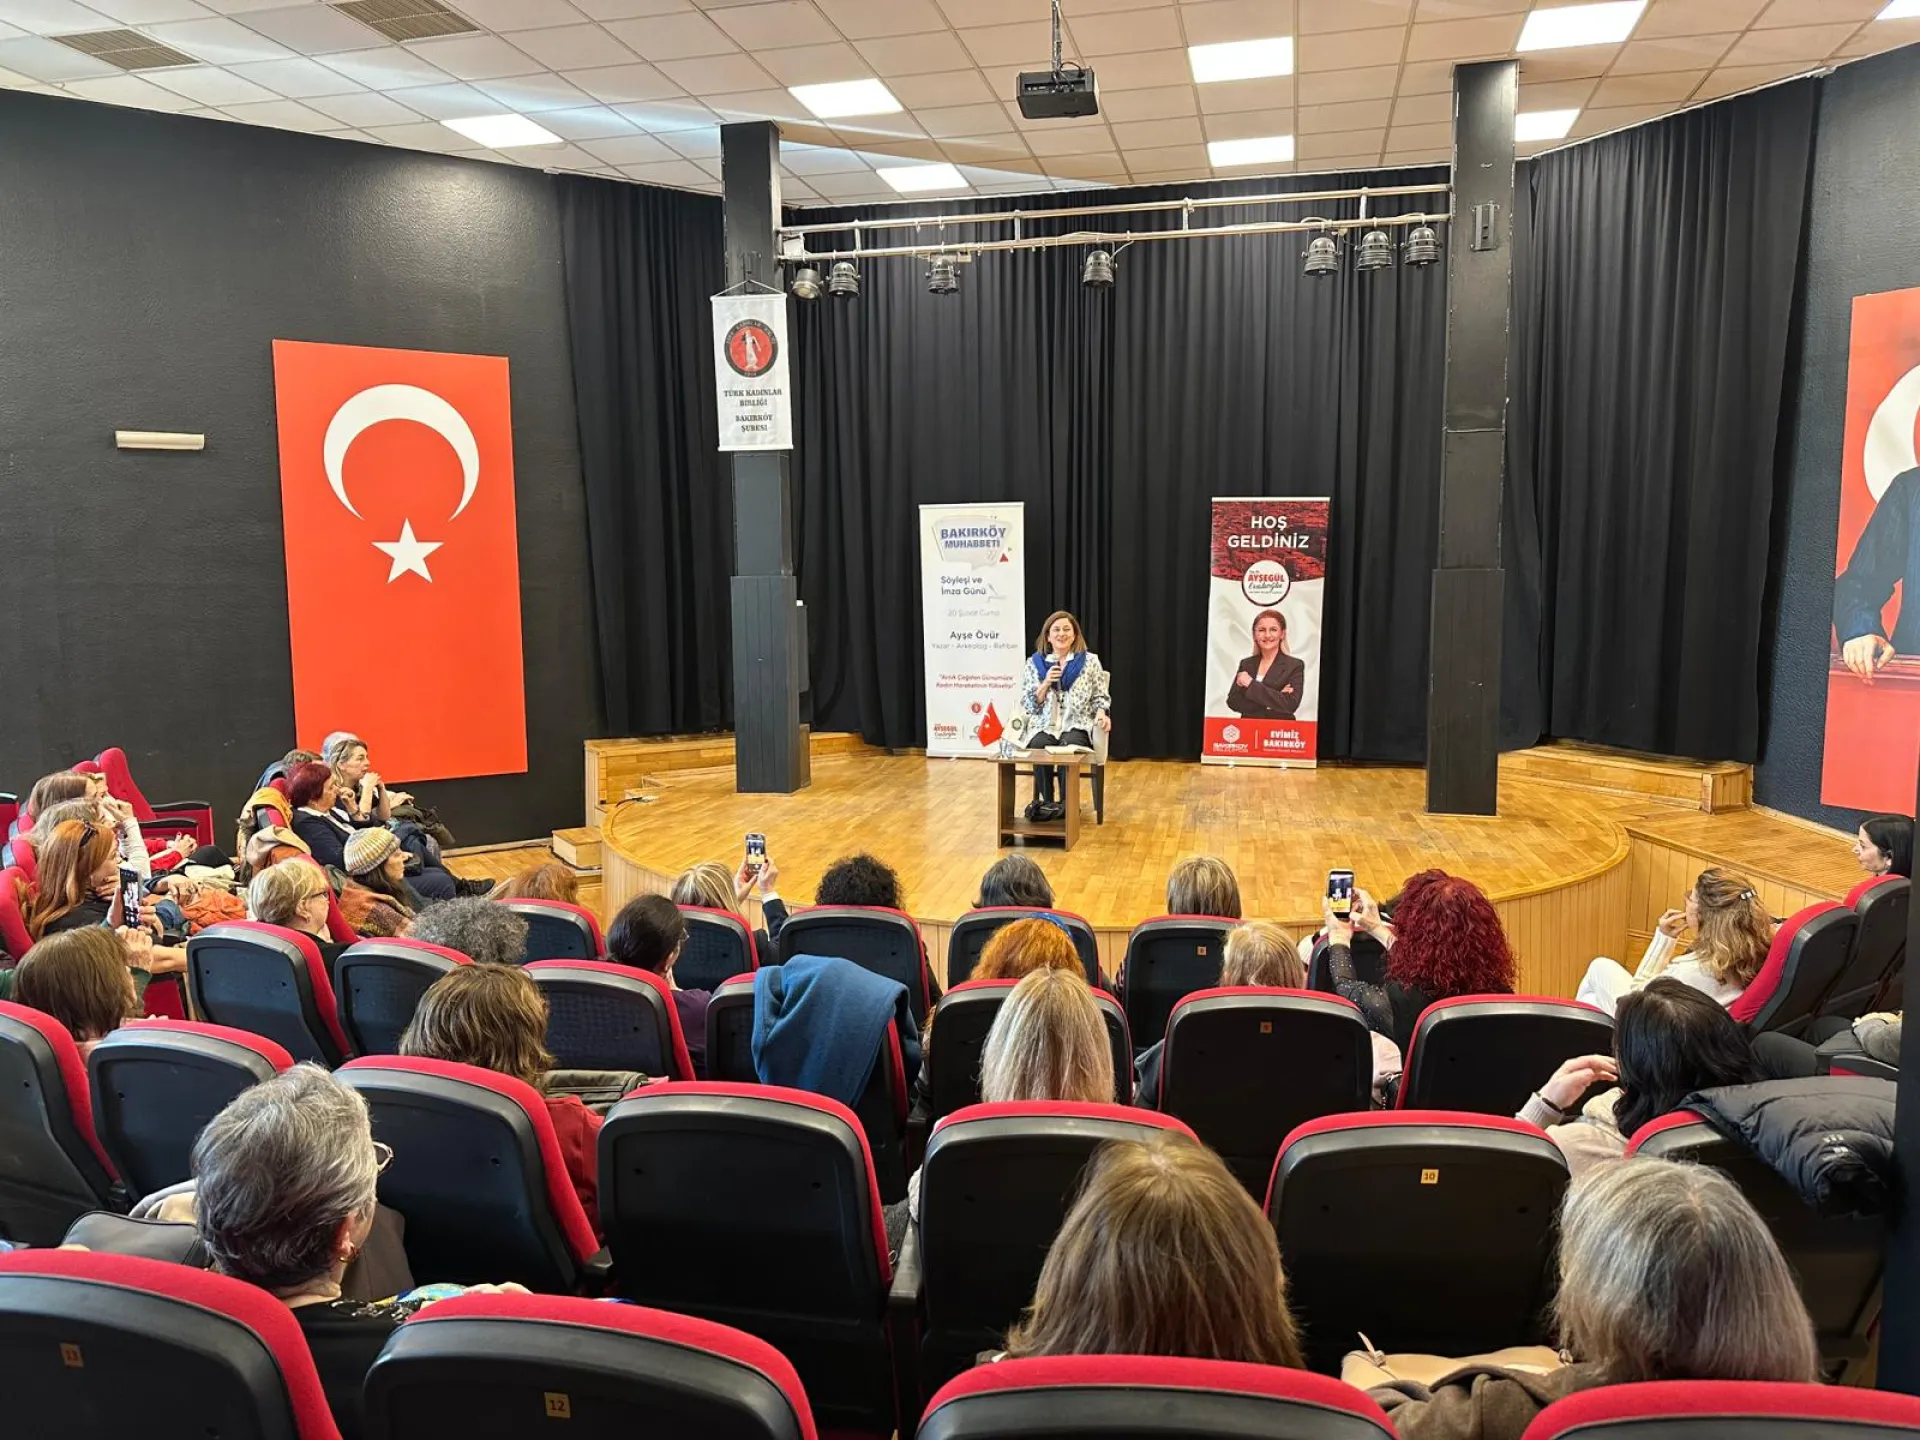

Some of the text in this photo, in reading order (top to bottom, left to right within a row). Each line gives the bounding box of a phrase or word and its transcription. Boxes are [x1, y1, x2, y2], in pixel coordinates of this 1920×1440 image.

[1251, 515, 1288, 531] HOŞ
[940, 524, 1006, 539] BAKIRKÖY
[1227, 532, 1310, 548] GELDİNİZ
[940, 575, 971, 585] Söyleşi
[941, 586, 986, 595] İmza Günü
[949, 629, 1000, 640] Ayşe Övür
[1270, 729, 1299, 739] EVİMİZ
[1263, 738, 1305, 749] BAKIRKÖY
[549, 1399, 566, 1411] 12
